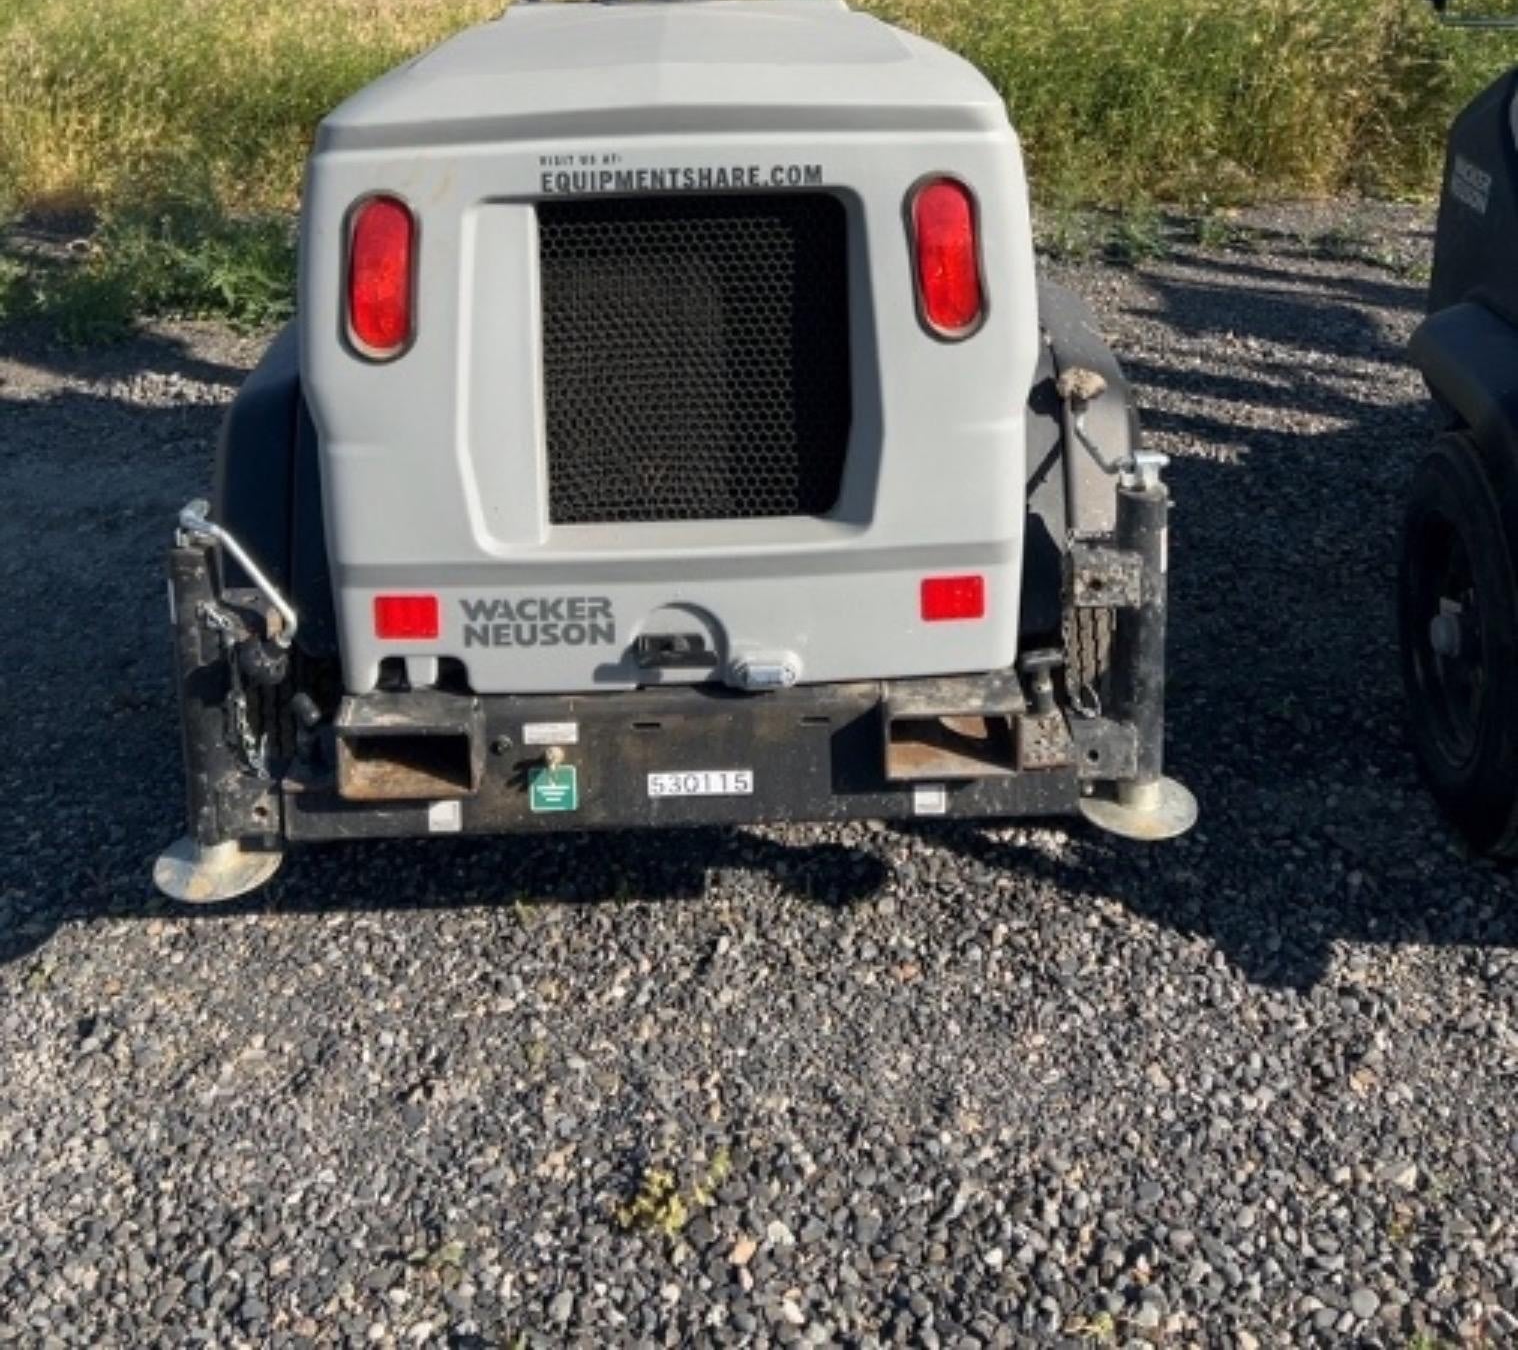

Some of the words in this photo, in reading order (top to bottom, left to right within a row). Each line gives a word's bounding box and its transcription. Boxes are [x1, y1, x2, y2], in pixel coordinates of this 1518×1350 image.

[541, 164, 823, 194] EQUIPMENTSHARE.COM
[458, 596, 614, 622] WACKER
[464, 622, 616, 648] NEUSON
[650, 772, 749, 795] 530115
